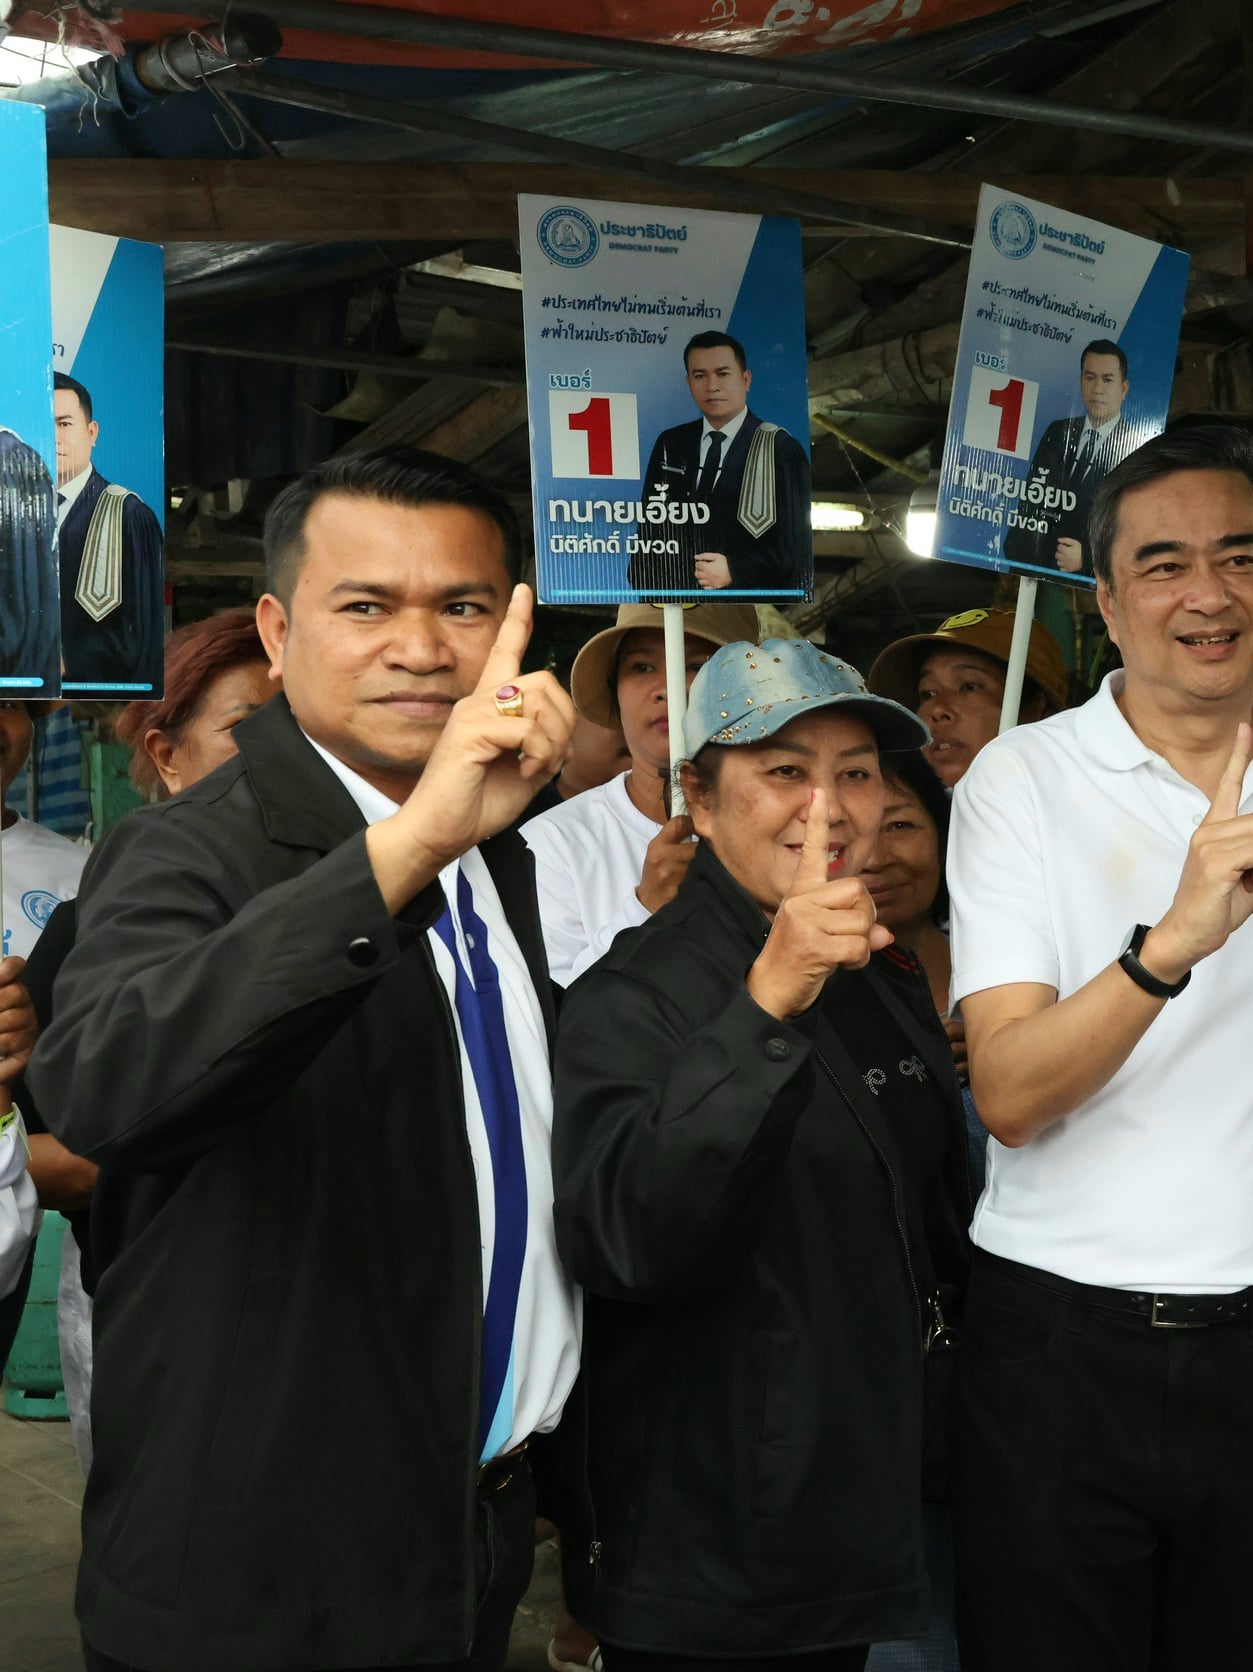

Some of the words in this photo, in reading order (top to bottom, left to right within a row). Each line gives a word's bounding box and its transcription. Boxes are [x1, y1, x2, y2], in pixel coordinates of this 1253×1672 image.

[600, 220, 688, 241] ประชาธิปัตย์
[1039, 222, 1105, 255] ประชาธิปัตย์
[541, 294, 722, 319] #ประเทศไทยไม่ทนเริ่มต้นที่เรา
[540, 318, 669, 345] #ฟ้าใหม่ประชาธิปัตย์
[975, 351, 1006, 371] เบอร
[549, 369, 592, 390] เบอร์
[988, 378, 1025, 453] 1
[568, 397, 613, 476] 1
[952, 462, 1077, 512] ทนายเอี้ยง
[549, 483, 711, 525] ทนายเอี้ยง
[549, 530, 620, 555] นิติศักดิ์
